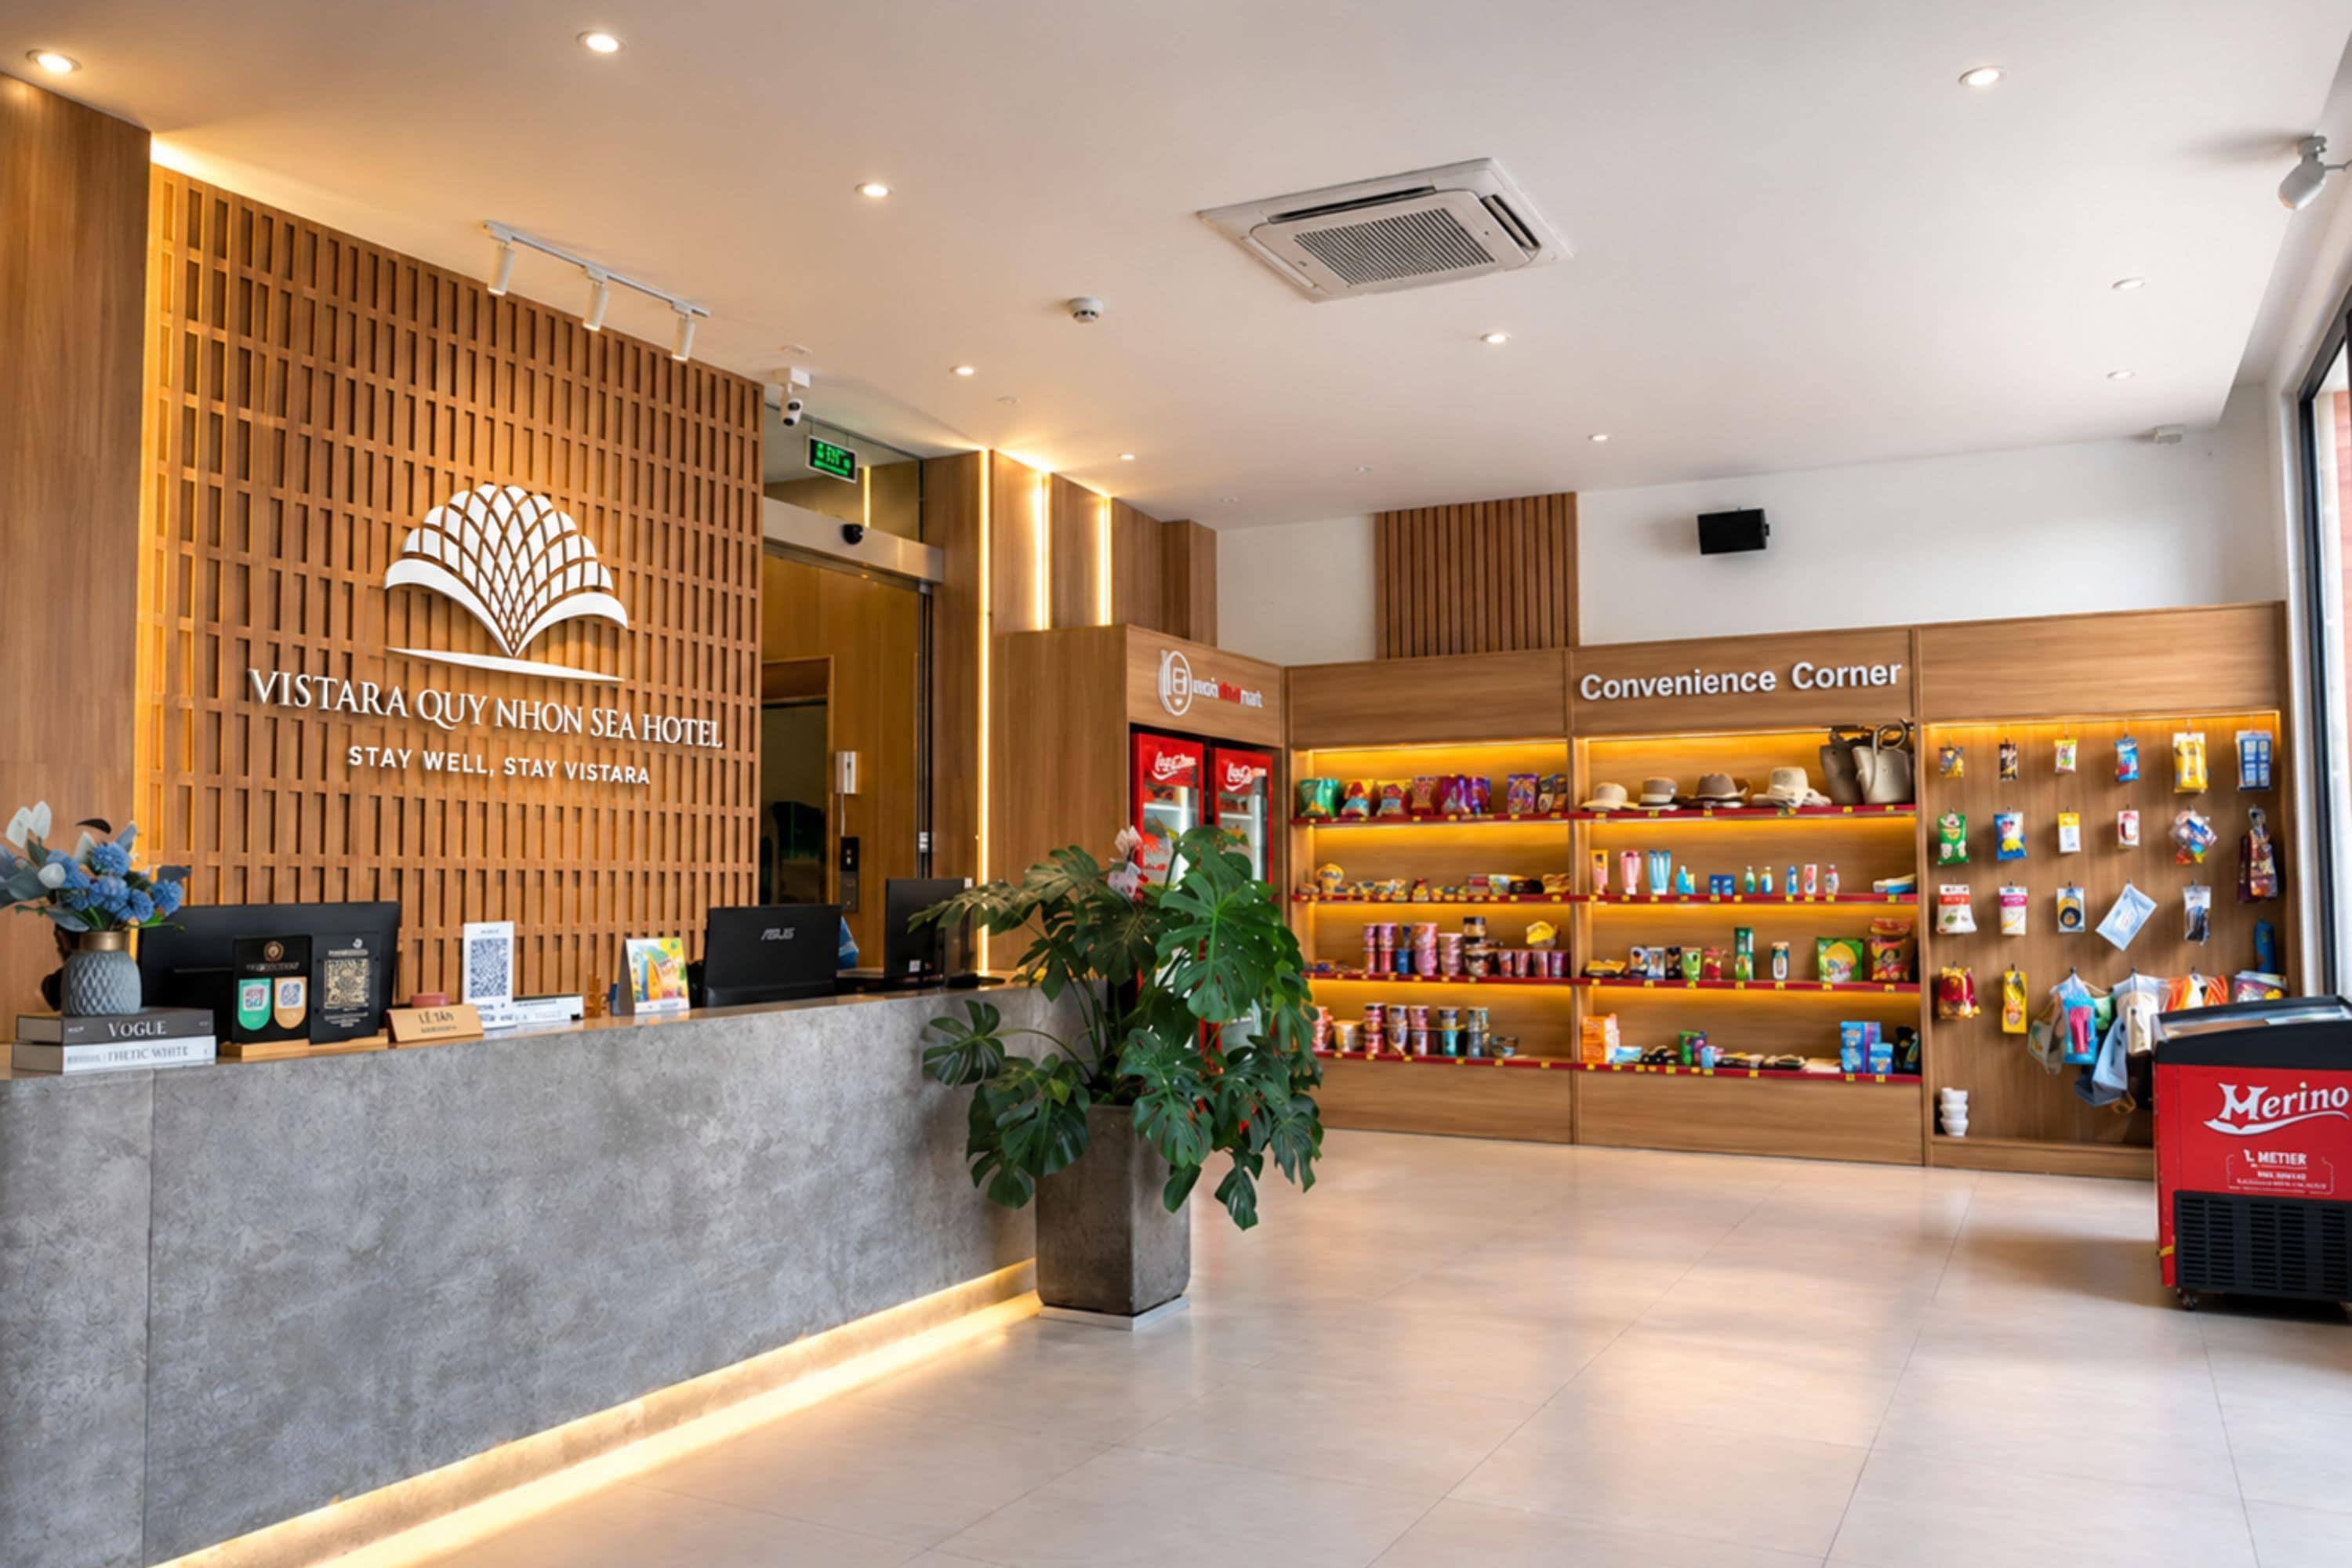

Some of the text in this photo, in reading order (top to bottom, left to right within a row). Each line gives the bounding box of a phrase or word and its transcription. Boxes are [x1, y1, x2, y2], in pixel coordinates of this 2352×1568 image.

[1580, 661, 1902, 700] Convenience Corner
[249, 669, 724, 748] VISTARA QUY NHON SEA HOTEL
[348, 746, 650, 784] STAY WELL, STAY VISTARA
[760, 927, 795, 941] ASUS
[107, 1020, 167, 1037] VOGUE
[152, 1046, 188, 1058] WHITE
[2217, 1081, 2350, 1121] Merino
